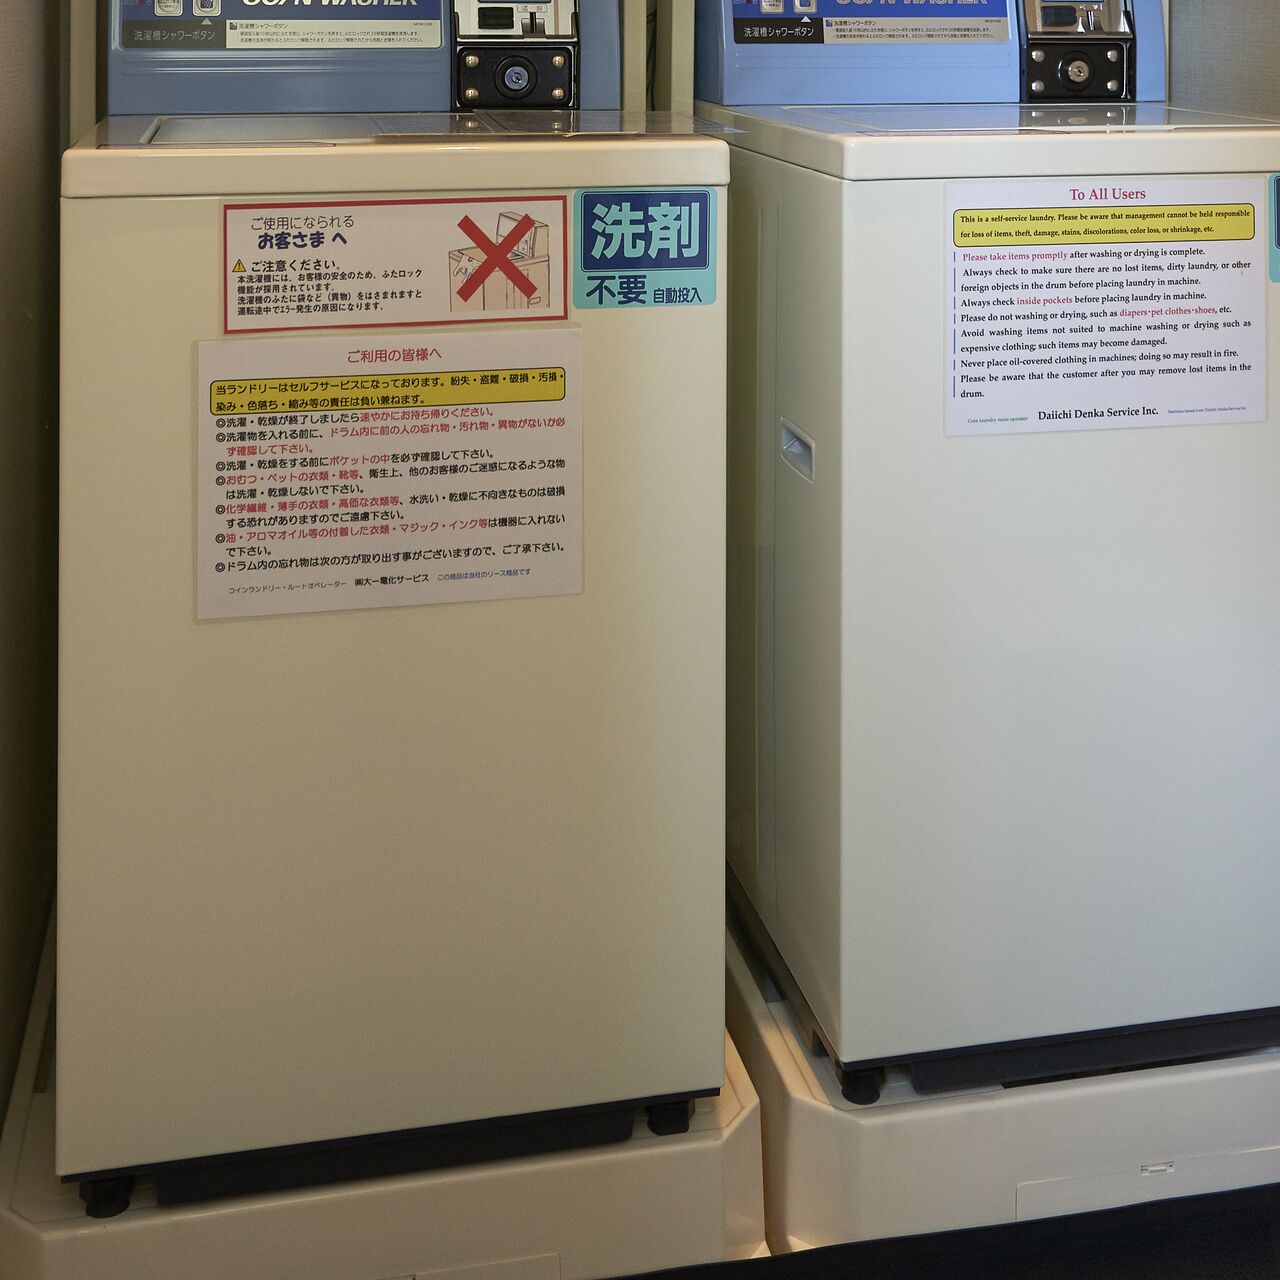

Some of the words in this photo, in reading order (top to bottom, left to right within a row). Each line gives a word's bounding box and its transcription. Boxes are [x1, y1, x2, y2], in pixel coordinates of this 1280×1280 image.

[134, 30, 215, 41] 洗濯槽シャワーボタン
[743, 27, 814, 37] 洗濯槽シャワーボタン
[1069, 188, 1085, 200] To
[1089, 188, 1108, 200] All
[1112, 187, 1146, 199] Users
[251, 215, 355, 231] ご使用になられる
[591, 202, 700, 260] 洗剤
[962, 253, 988, 261] Please
[1008, 252, 1030, 260] items
[1031, 251, 1068, 261] promptly
[1069, 251, 1088, 259] after
[1090, 250, 1122, 259] washing
[1133, 249, 1160, 258] drying
[1169, 248, 1205, 257] complete.
[251, 259, 341, 273] ご注意ください。
[586, 274, 647, 305] 不要
[653, 288, 702, 304] 自動投入
[347, 348, 442, 364] ご利用の皆様へ
[960, 360, 985, 368] Never
[986, 359, 1008, 369] place
[1009, 356, 1053, 366] oil-covered
[1054, 355, 1087, 365] clothing
[1089, 354, 1097, 363] in
[1098, 353, 1137, 362] machines;
[1138, 352, 1161, 362] doing
[1173, 352, 1189, 361] may
[1190, 350, 1212, 359] result
[1214, 349, 1222, 357] in
[1223, 349, 1239, 357] fire.
[960, 390, 985, 398] drum.
[1038, 409, 1072, 420] Daiichi
[1074, 408, 1105, 419] Denka
[1107, 407, 1140, 417] Service
[1142, 406, 1159, 416] Inc.
[226, 546, 272, 557] で下さい。
